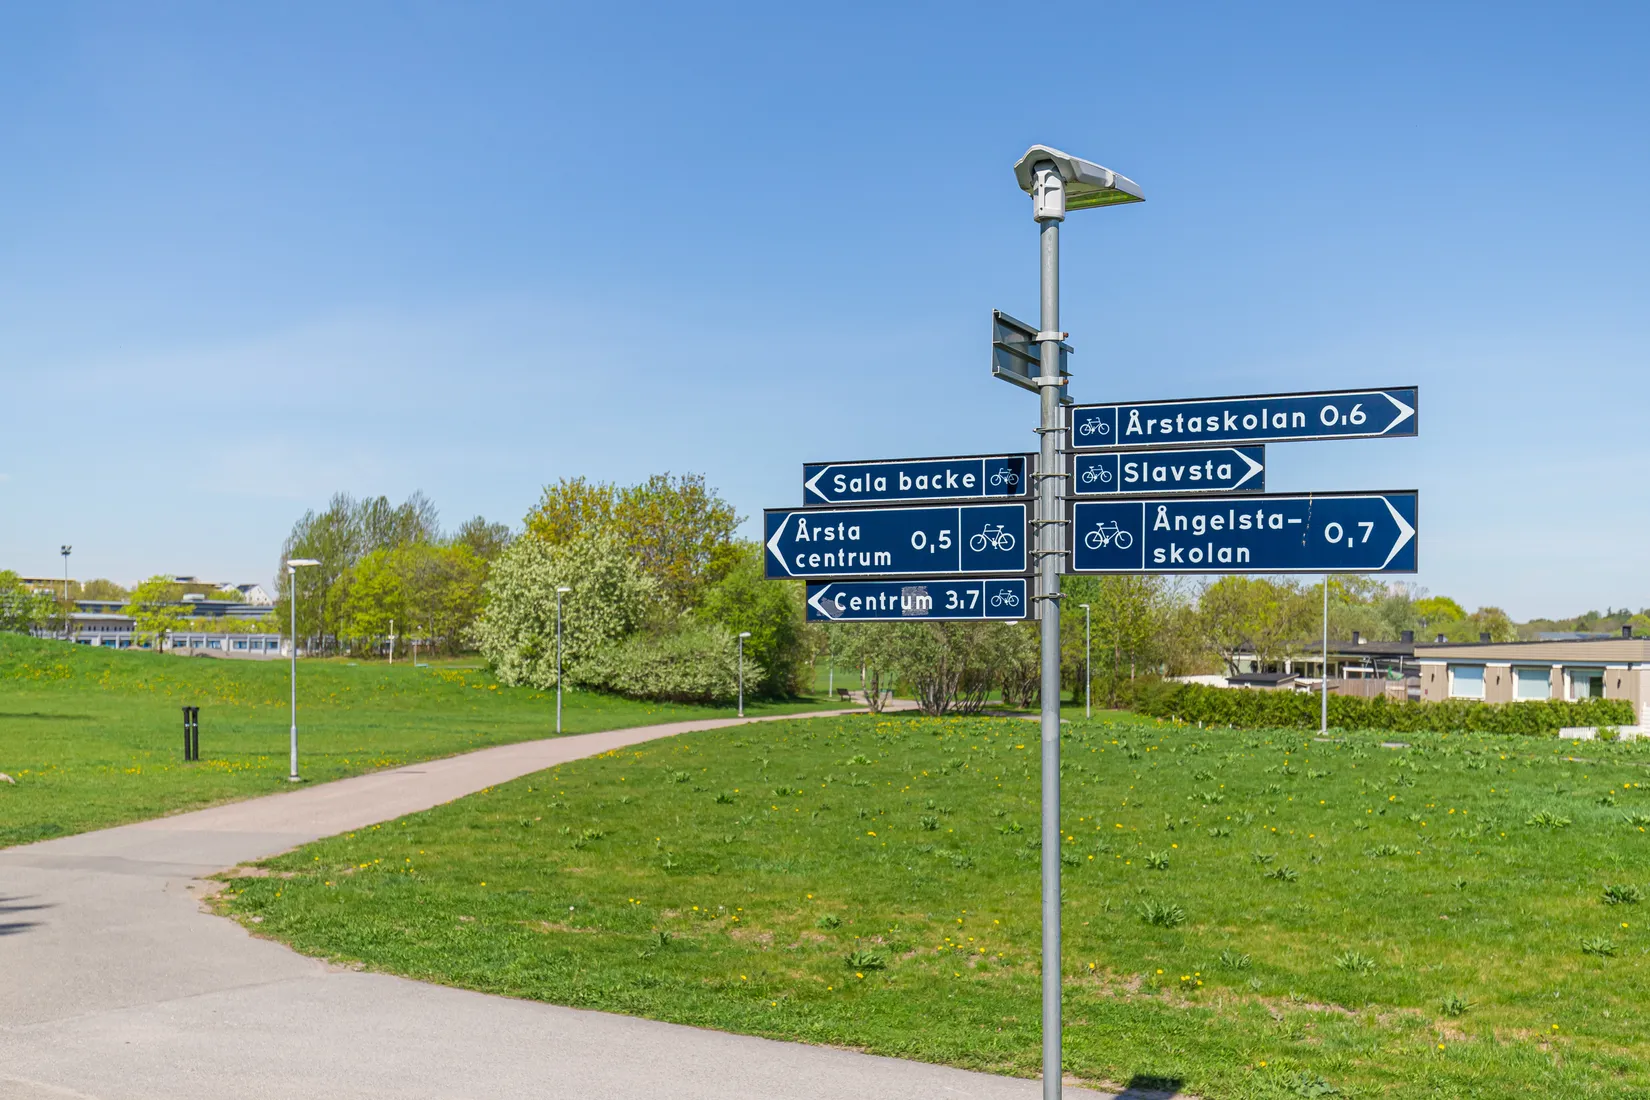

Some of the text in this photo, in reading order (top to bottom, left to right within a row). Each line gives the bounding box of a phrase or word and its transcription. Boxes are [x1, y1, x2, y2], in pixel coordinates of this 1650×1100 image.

[1125, 403, 1367, 436] Årstaskolan 0,6
[833, 470, 976, 494] Sala backe
[1123, 459, 1232, 483] Slavsta
[795, 517, 861, 542] Årsta
[1153, 505, 1302, 536] Ångelsta-
[910, 529, 952, 554] 0,5
[1323, 521, 1375, 548] 0,7
[795, 548, 892, 568] centrum
[1153, 542, 1251, 564] skolan
[834, 589, 980, 612] Centrum 3,7
